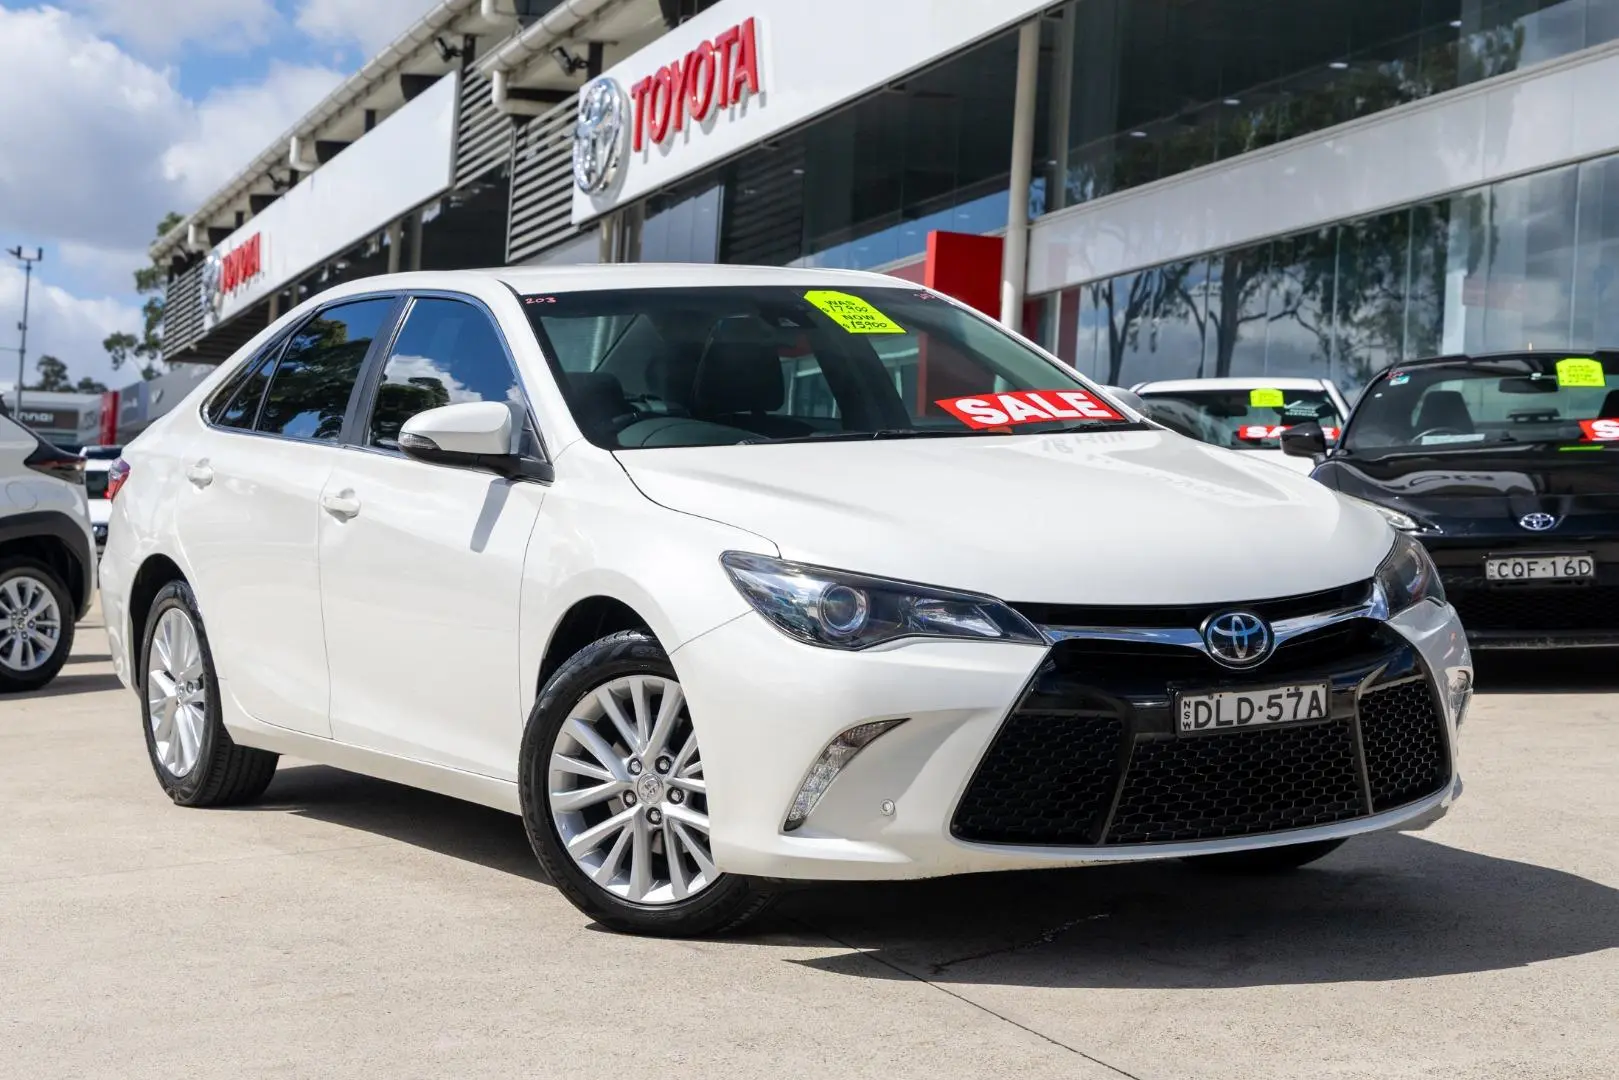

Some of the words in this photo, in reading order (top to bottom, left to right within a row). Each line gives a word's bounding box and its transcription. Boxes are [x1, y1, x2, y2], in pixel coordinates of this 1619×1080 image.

[630, 17, 759, 153] TOYOTA
[525, 296, 557, 304] 203
[956, 392, 1113, 425] SALE
